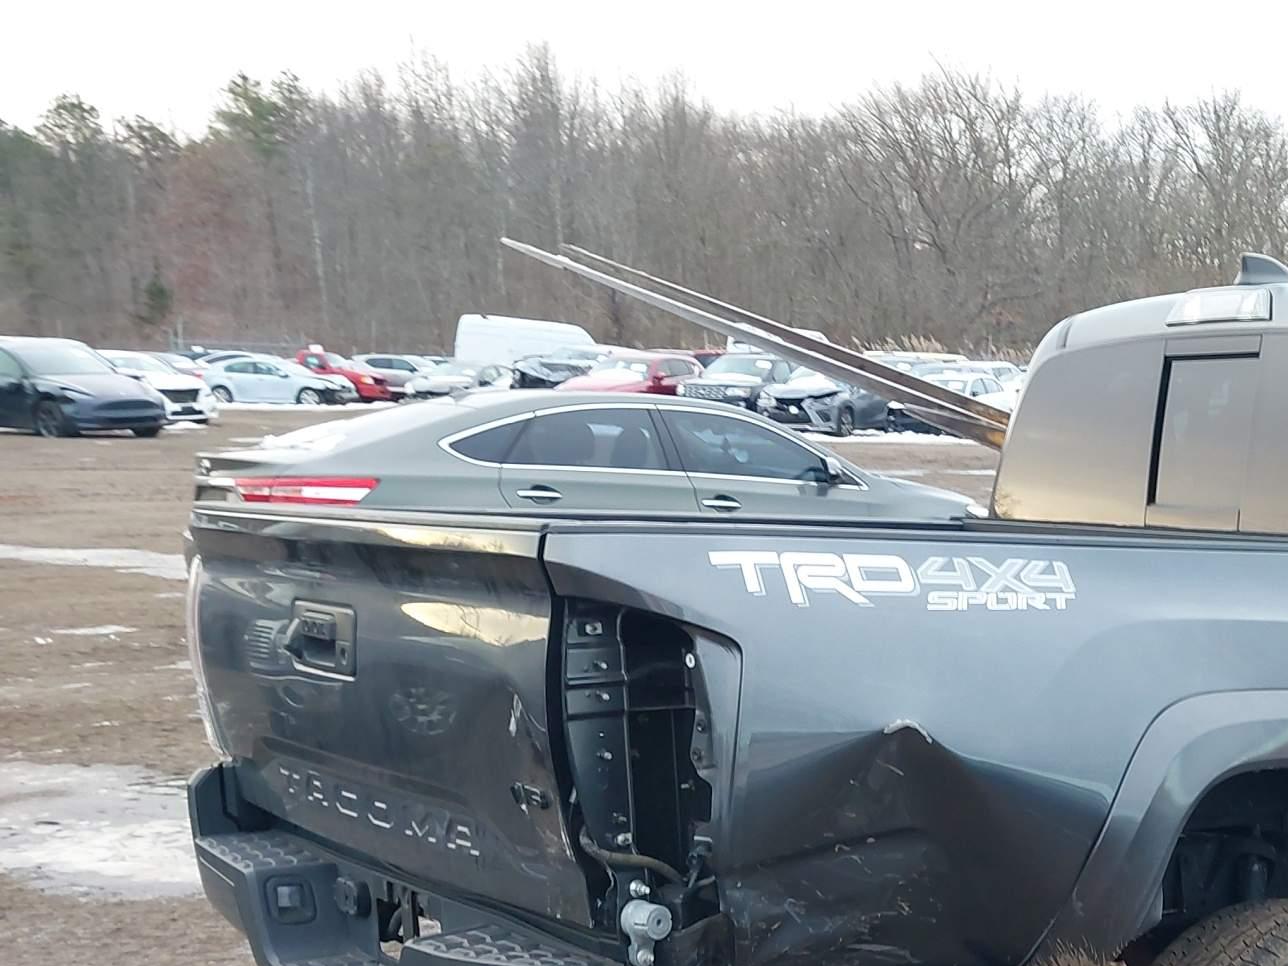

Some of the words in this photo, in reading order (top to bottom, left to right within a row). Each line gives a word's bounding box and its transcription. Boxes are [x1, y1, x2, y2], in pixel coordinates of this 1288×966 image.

[707, 551, 921, 608] TRD
[926, 590, 1077, 611] SPORT
[278, 766, 481, 857] TACOMA
